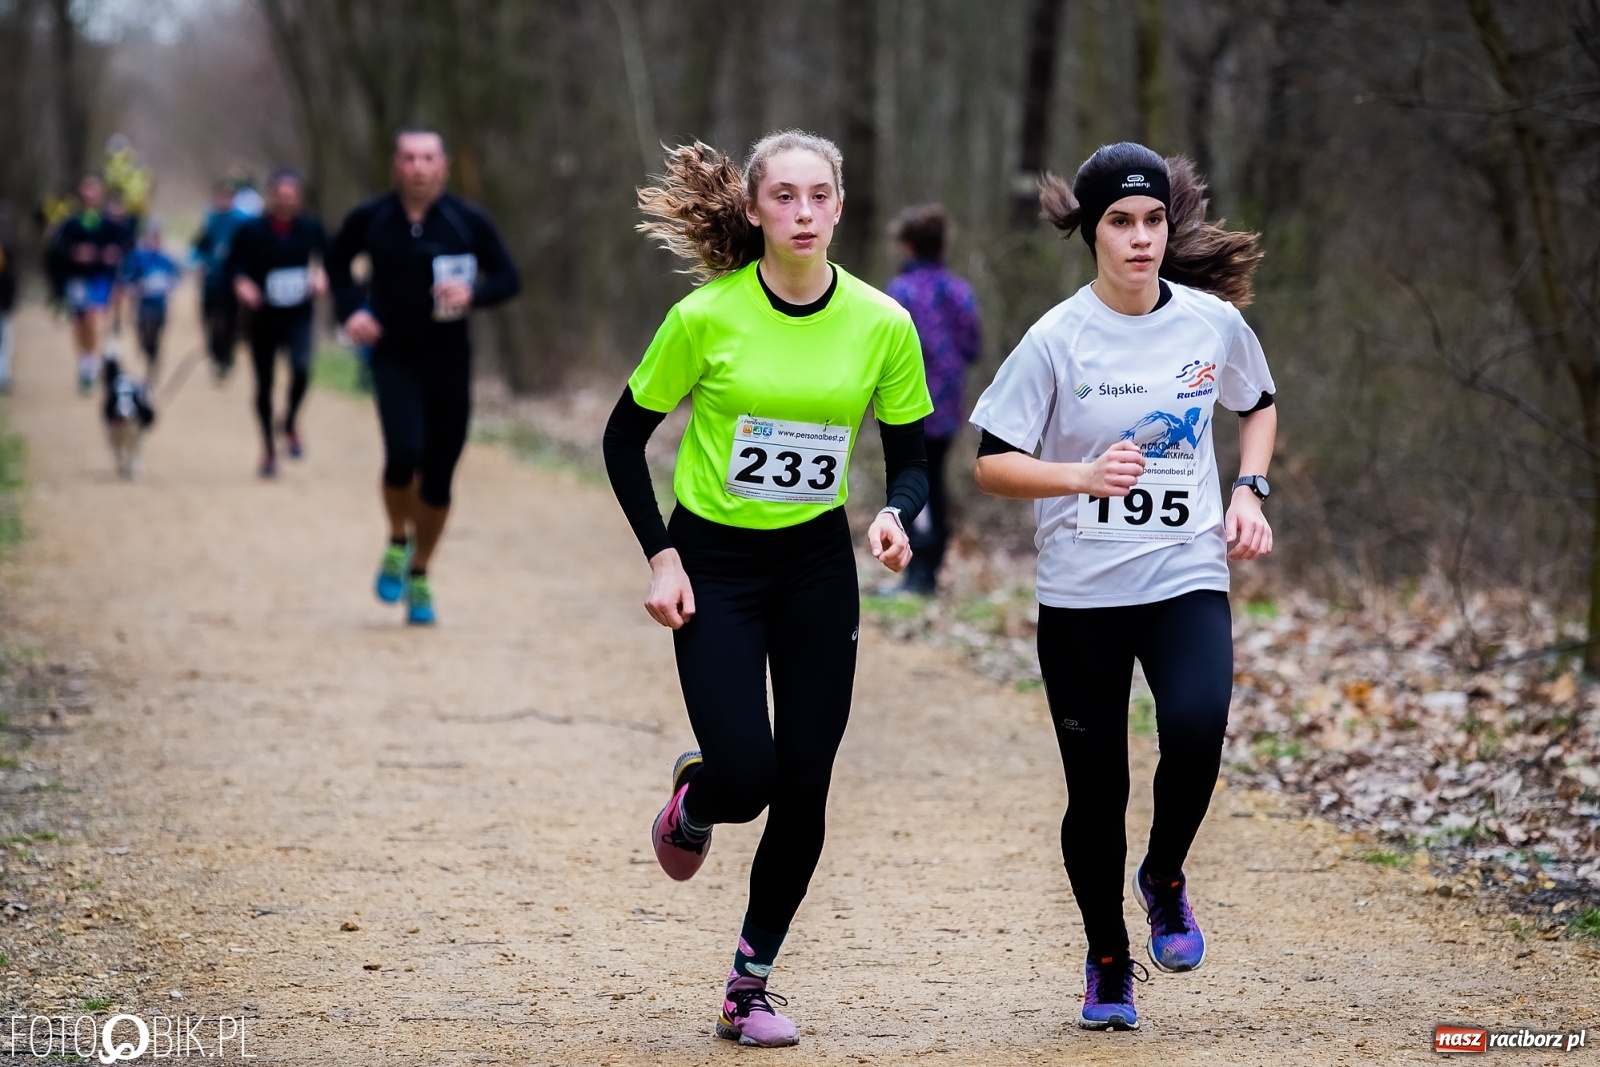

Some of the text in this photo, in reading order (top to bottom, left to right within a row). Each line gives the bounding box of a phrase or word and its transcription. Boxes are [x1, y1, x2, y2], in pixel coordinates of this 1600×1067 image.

[1099, 383, 1148, 398] Śląskie.
[777, 429, 846, 443] www.personalbest.pl
[734, 446, 837, 490] 233
[1088, 488, 1190, 527] 195
